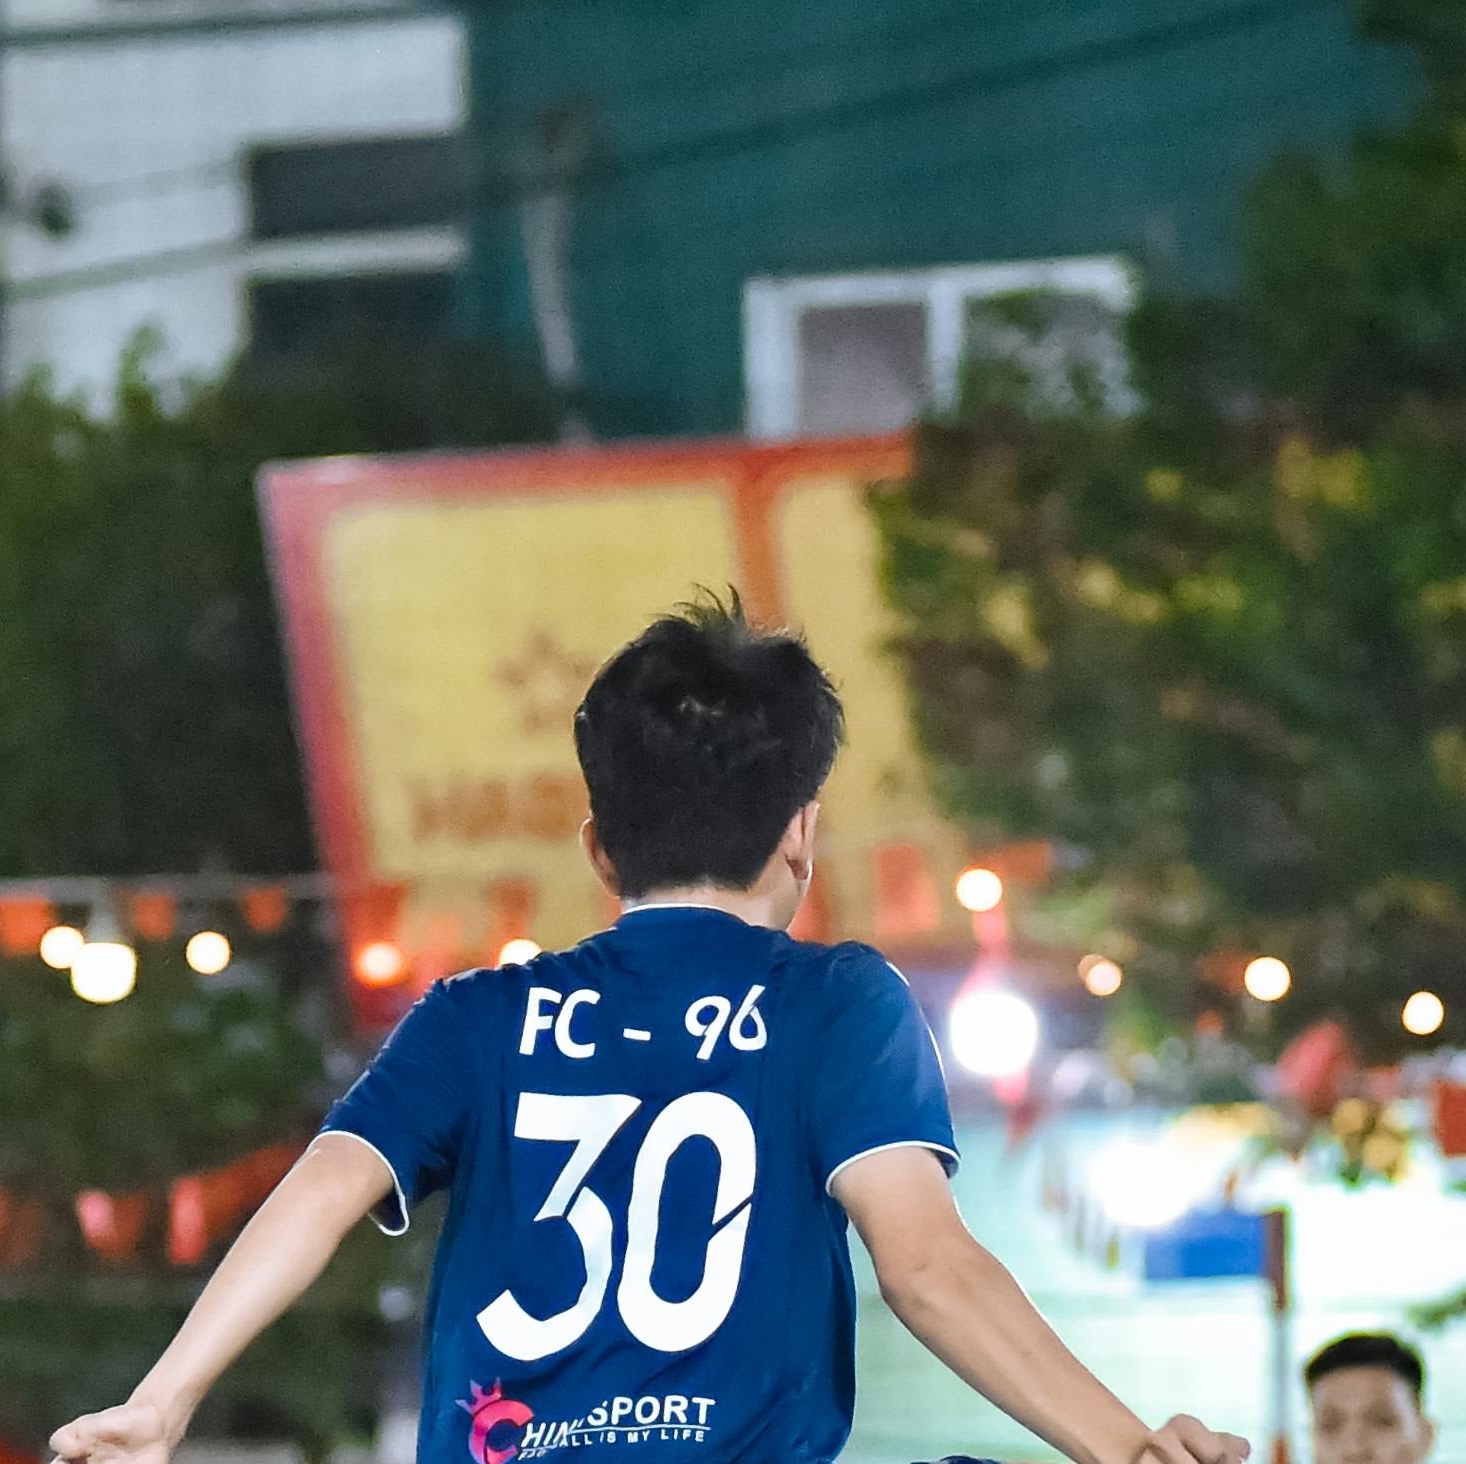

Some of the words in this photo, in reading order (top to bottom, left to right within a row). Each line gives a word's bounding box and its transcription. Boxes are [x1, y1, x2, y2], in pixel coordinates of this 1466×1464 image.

[519, 986, 601, 1058] FC
[623, 1028, 651, 1041] -
[684, 984, 768, 1060] 96
[475, 1091, 757, 1361] 30
[587, 1395, 716, 1426] SPORT
[627, 1430, 651, 1444] MY
[660, 1428, 705, 1443] LIFE
